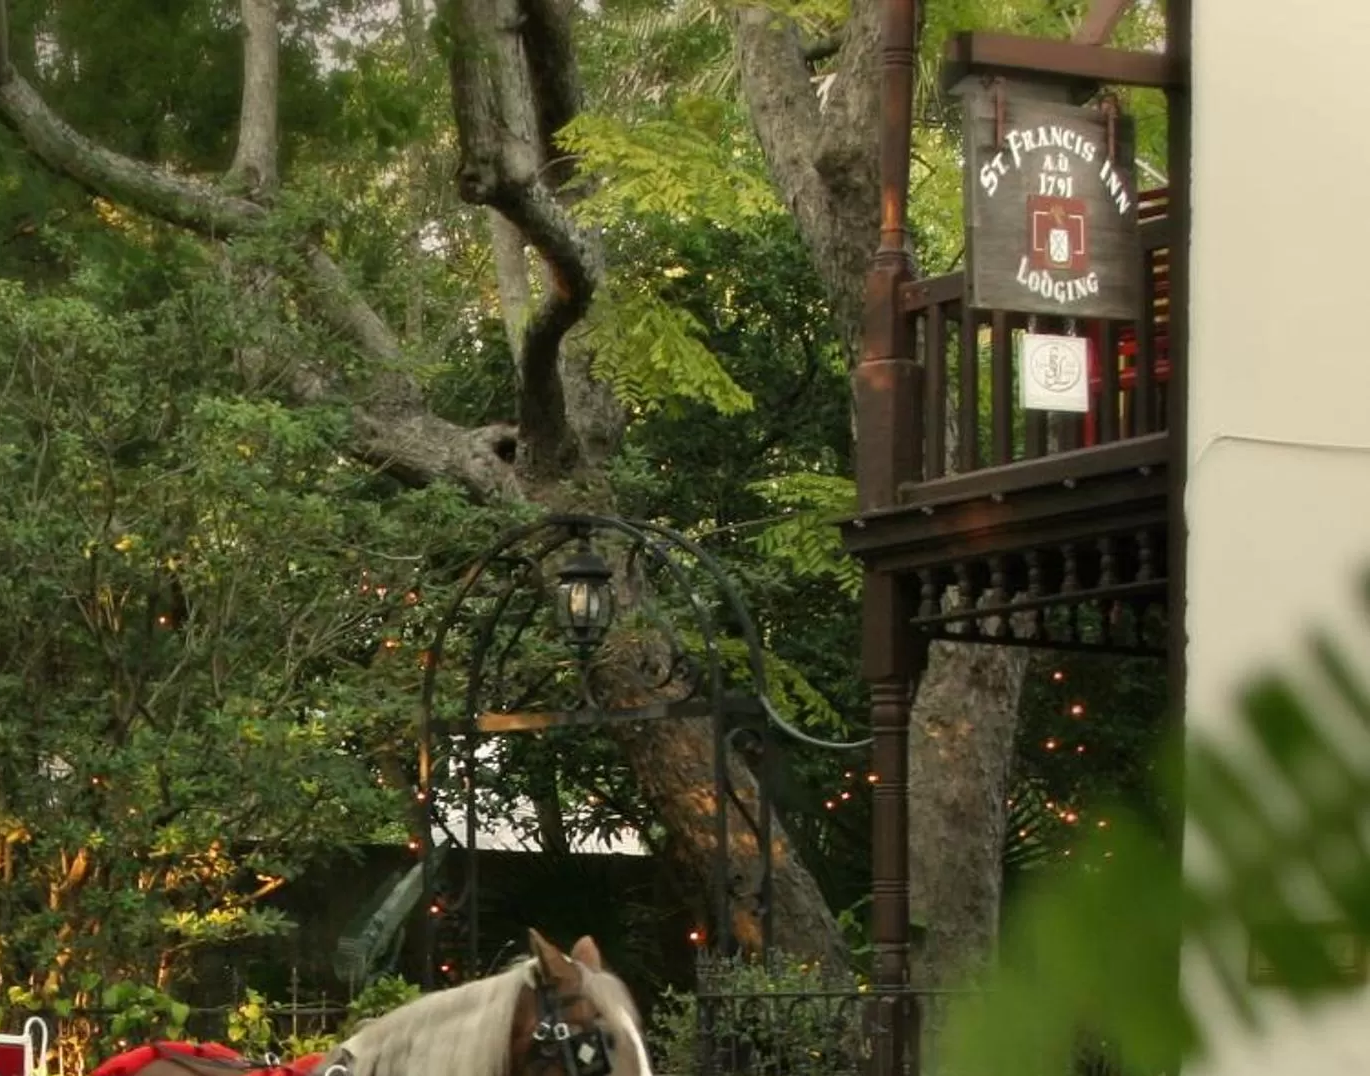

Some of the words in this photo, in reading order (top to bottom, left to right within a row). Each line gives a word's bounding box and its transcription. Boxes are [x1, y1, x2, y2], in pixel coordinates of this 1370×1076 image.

[1005, 126, 1096, 168] FRANCIS
[1099, 160, 1131, 215] INN
[1038, 173, 1074, 198] 1791
[1016, 256, 1099, 304] LODGING
